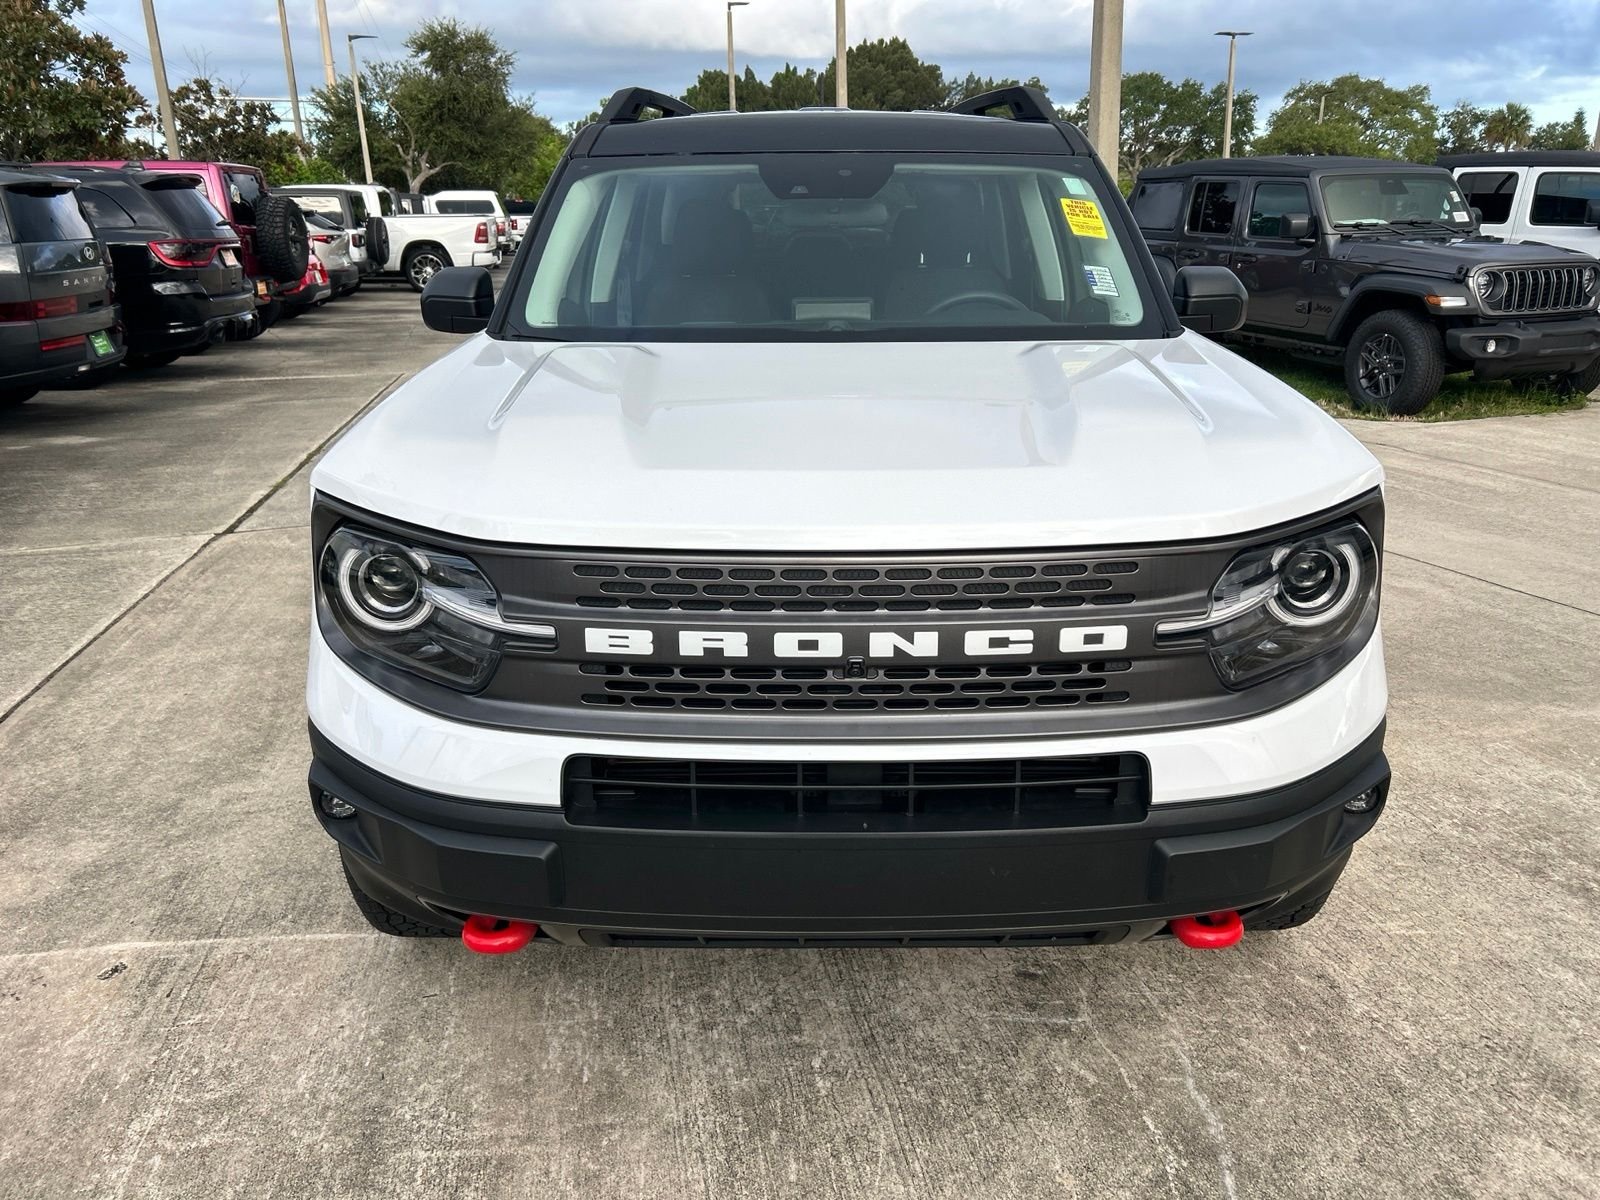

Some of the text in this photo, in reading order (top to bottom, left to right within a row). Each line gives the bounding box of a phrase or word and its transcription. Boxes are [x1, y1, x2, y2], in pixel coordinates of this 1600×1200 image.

[1065, 203, 1094, 211] VEHICLE
[63, 276, 102, 287] SANTA
[584, 624, 1129, 658] BRONCO
